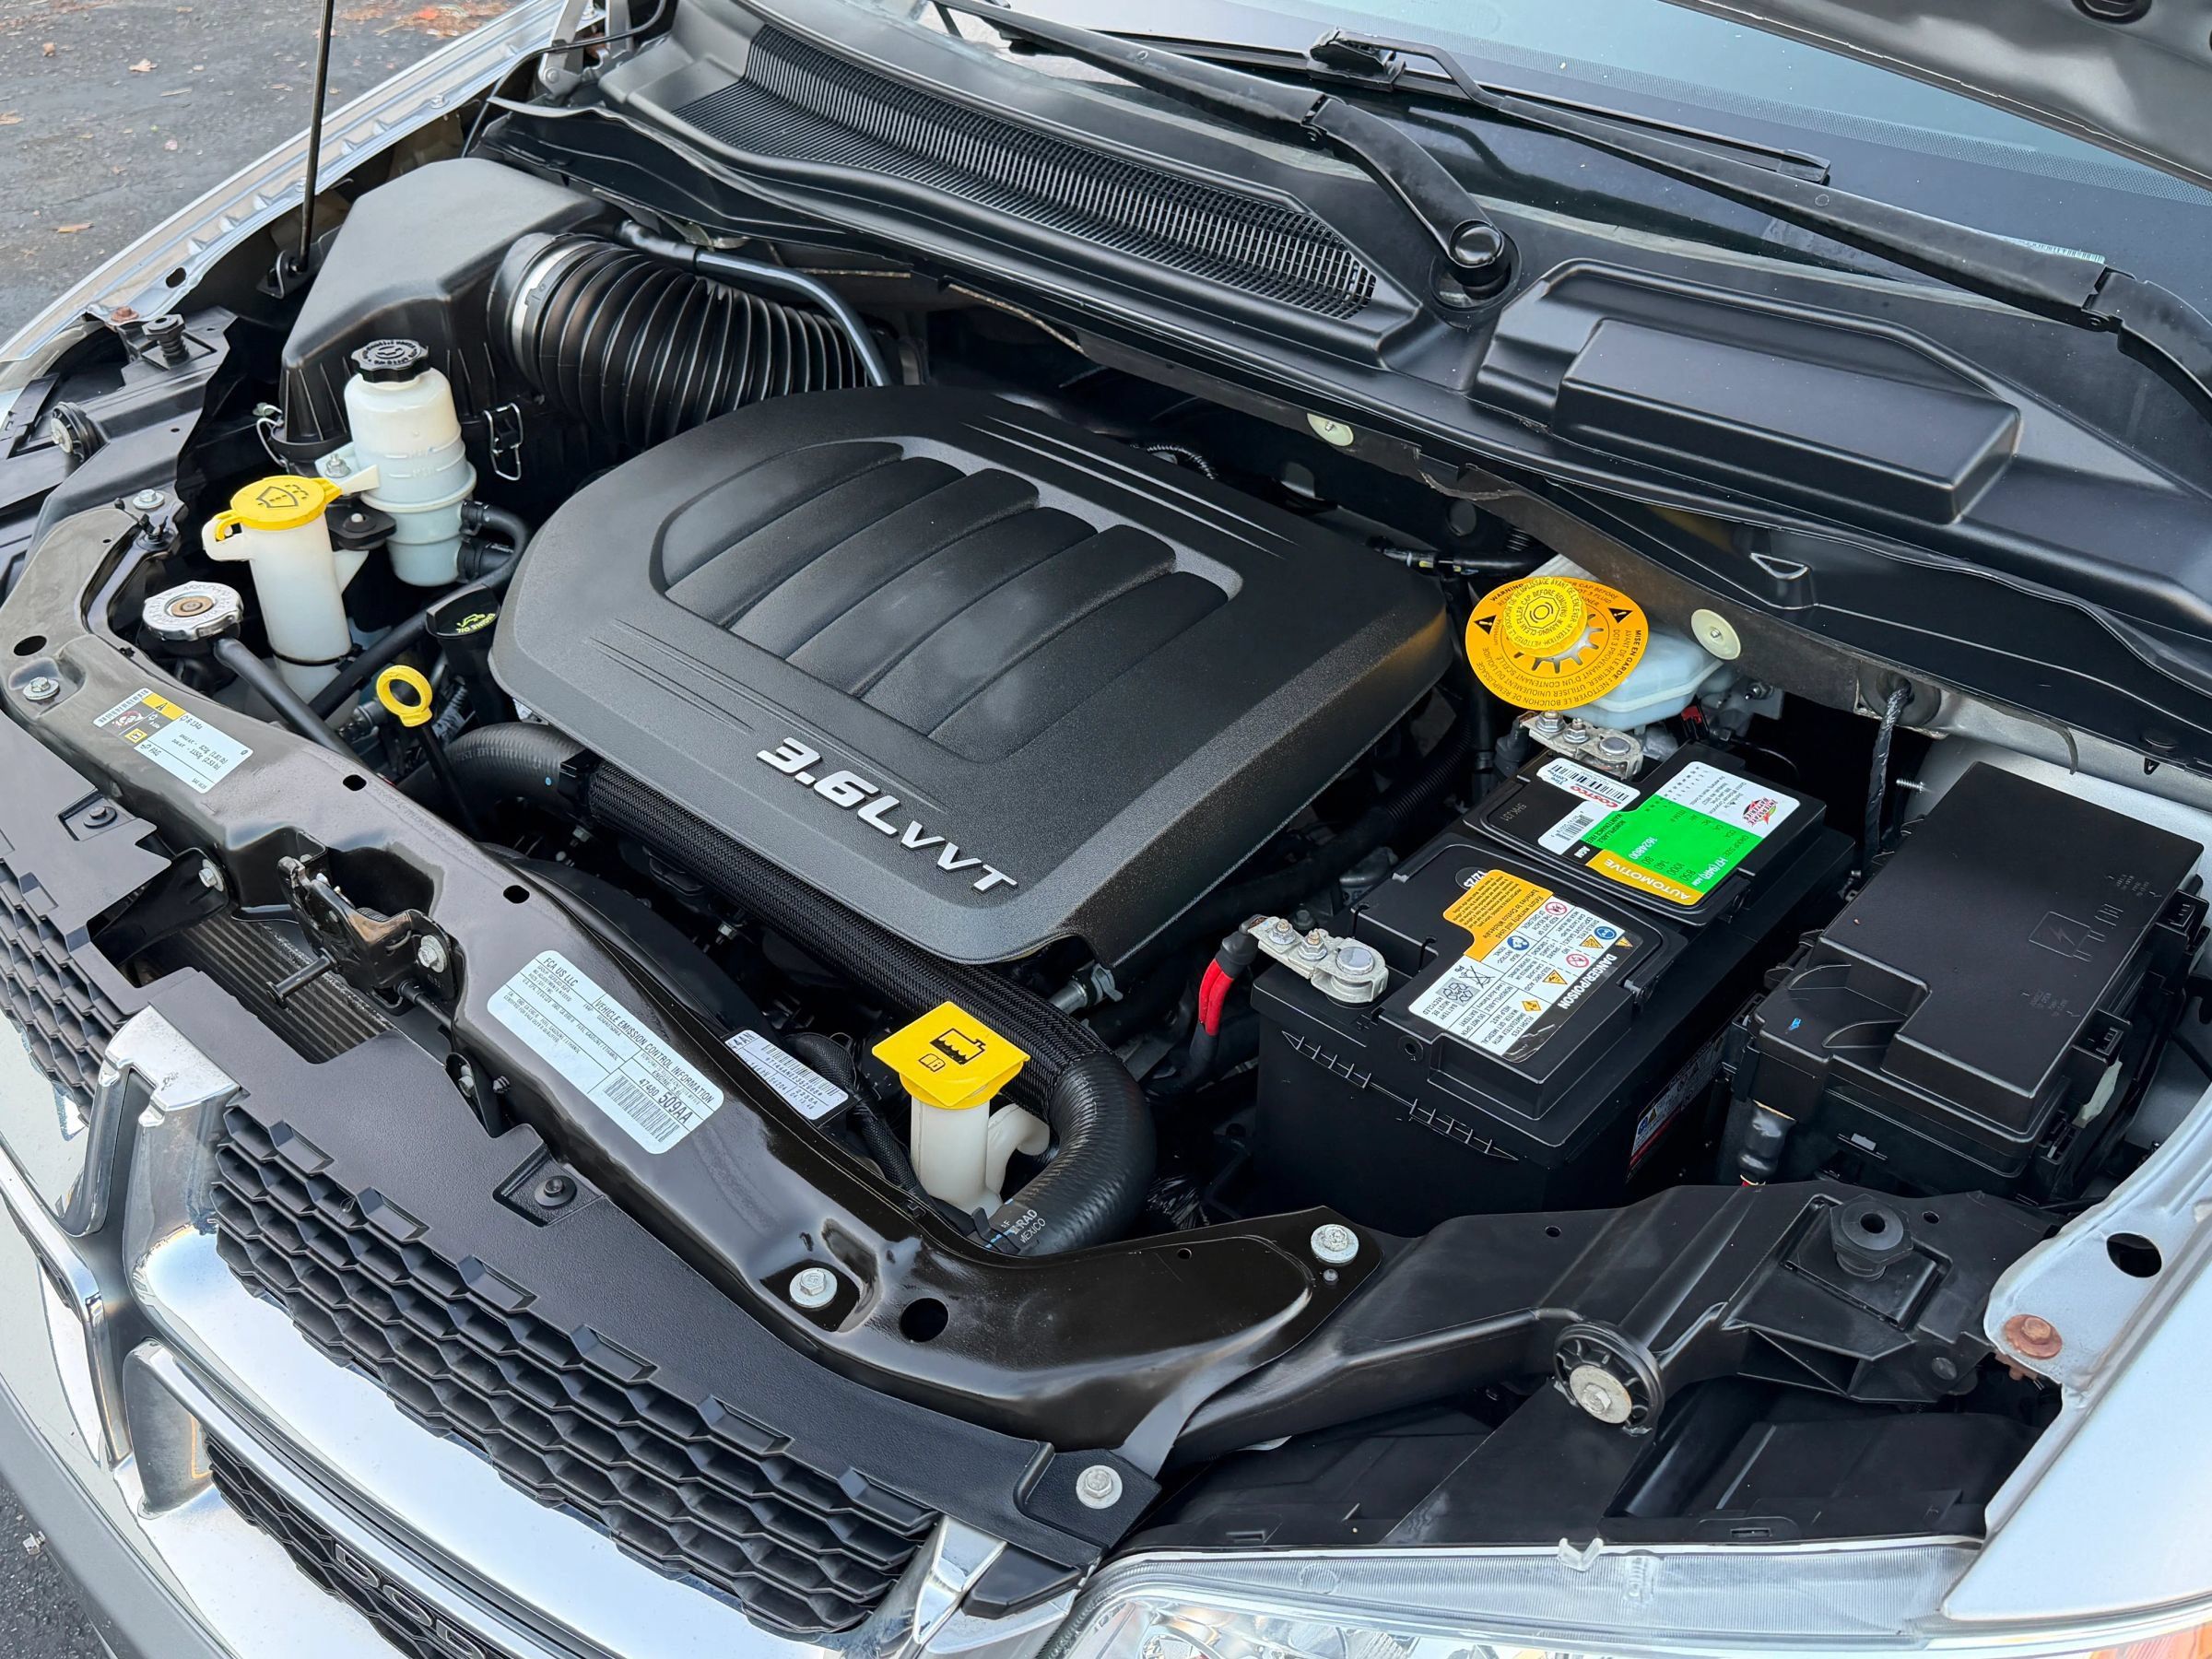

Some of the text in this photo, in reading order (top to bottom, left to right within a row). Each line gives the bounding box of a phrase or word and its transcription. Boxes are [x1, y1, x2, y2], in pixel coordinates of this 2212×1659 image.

[1514, 579, 1548, 599] REMPLISSAGE
[1550, 579, 1568, 588] AVANT
[1521, 594, 1531, 605] CAP
[1533, 588, 1554, 597] BEFORE
[1630, 647, 1639, 656] EN
[1477, 661, 1512, 696] REMPLISSAGE
[1496, 669, 1505, 678] DU
[1515, 670, 1559, 687] CONTENANT
[1613, 657, 1632, 680] GARDE
[1503, 676, 1550, 696] UNIQUEMENT
[1512, 692, 1521, 700] DE
[1552, 684, 1584, 697] UTILISER
[1574, 681, 1609, 701] NETTOYER
[1523, 697, 1560, 706] BOUCHON
[1568, 783, 1619, 809] COSTCO
[1740, 797, 1770, 820] BATTERIES
[1746, 799, 1778, 826] INTERSTATE
[1603, 857, 1691, 900] AUTOMOTIVE
[1677, 869, 1696, 880] 850
[542, 957, 559, 971] FCA
[553, 966, 567, 978] US
[562, 973, 579, 987] LLC
[1556, 952, 1618, 1009] DANGER/POISON
[1420, 995, 1443, 1015] RECYCLED
[1436, 999, 1451, 1010] MUST
[1438, 1003, 1458, 1020] BATTERY
[1498, 1005, 1512, 1015] HELP
[1490, 1012, 1526, 1044] IMMEDIATELY WITH
[1495, 1020, 1507, 1030] GET
[1510, 1015, 1535, 1037] FLUSH EYES
[1479, 1028, 1500, 1045] MEDICAL
[593, 999, 620, 1023] VEHICLE
[616, 1018, 648, 1046] EMISSION
[642, 1042, 675, 1069] CONTROL
[669, 1065, 715, 1104] INFORMATION
[656, 1090, 695, 1124] 509AA
